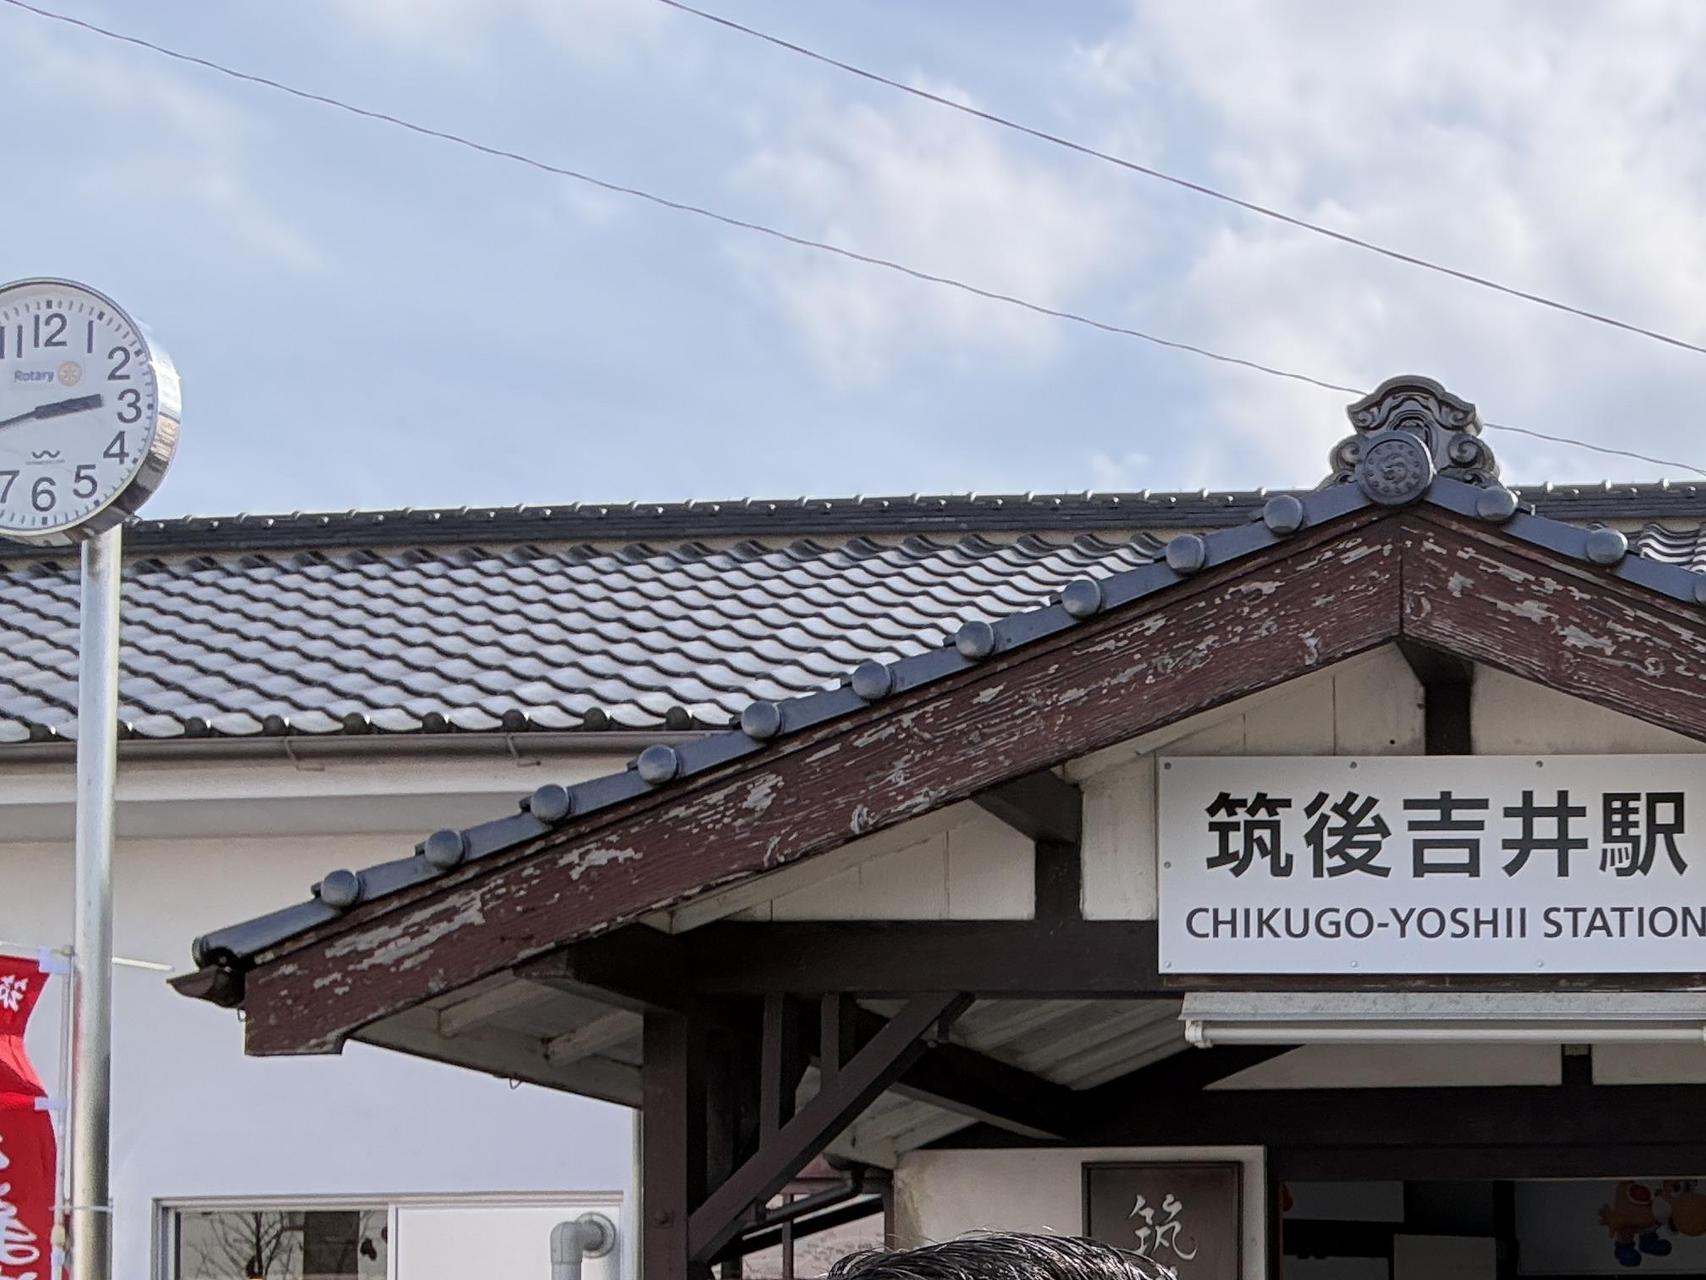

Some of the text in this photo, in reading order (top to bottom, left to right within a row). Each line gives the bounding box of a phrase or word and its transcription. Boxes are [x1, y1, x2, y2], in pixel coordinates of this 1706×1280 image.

[34, 313, 67, 348] 12
[86, 320, 94, 354] 1
[14, 370, 54, 383] Rotary
[107, 346, 131, 381] 2
[117, 388, 142, 424] 3
[103, 431, 129, 465] 4
[0, 470, 20, 504] 7
[31, 477, 56, 512] 6
[73, 464, 98, 499] 5
[1205, 790, 1688, 879] 筑後吉井駅
[1186, 907, 1528, 939] CHIKUGO-YOSHII
[1128, 1193, 1198, 1276] 筑
